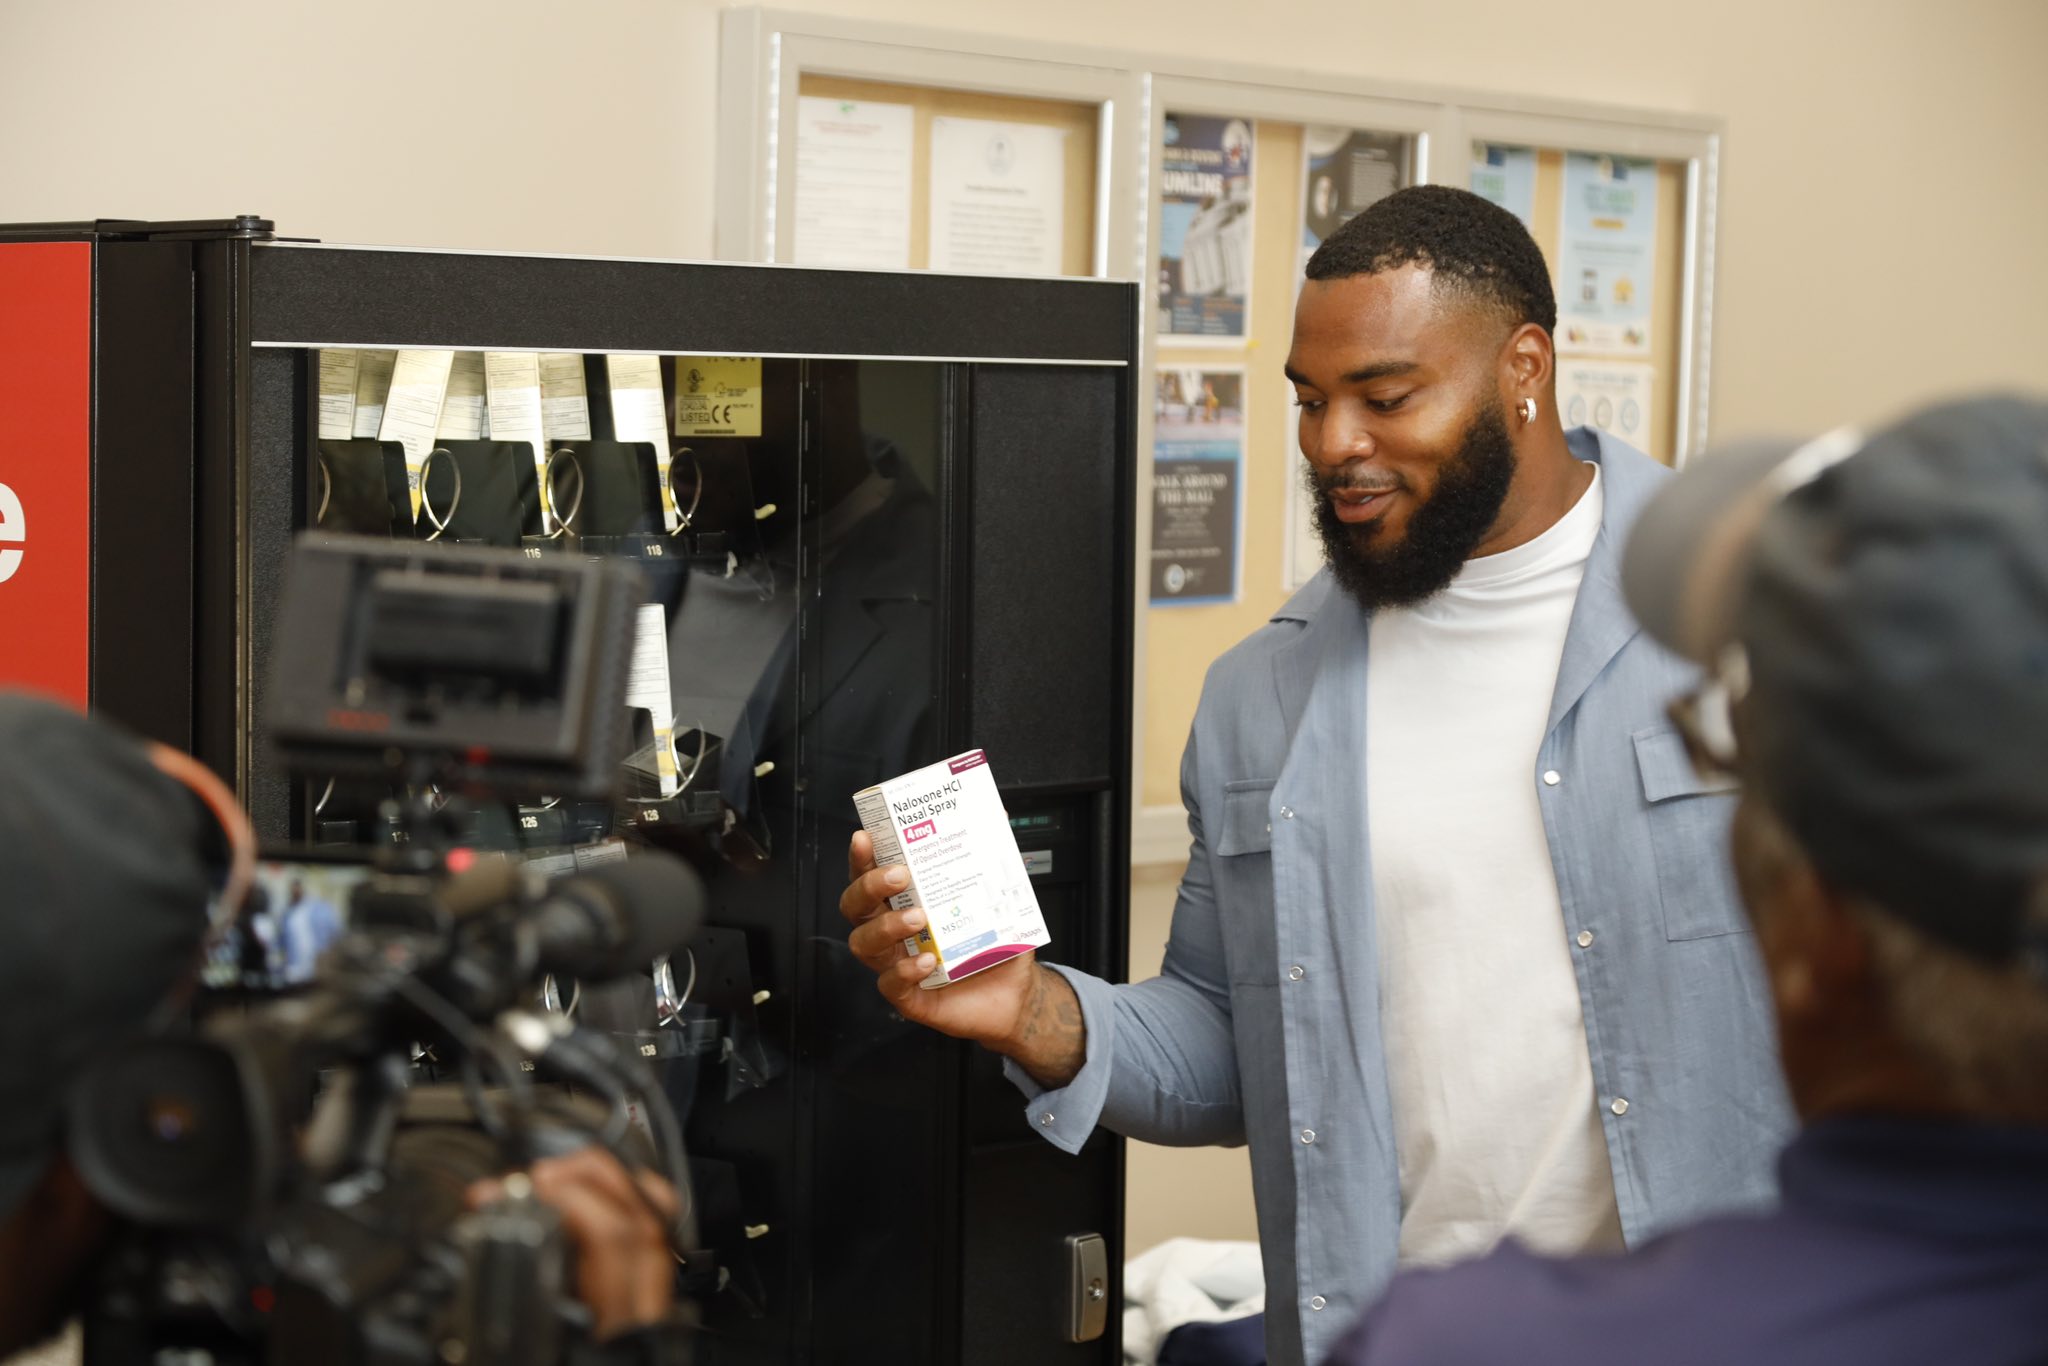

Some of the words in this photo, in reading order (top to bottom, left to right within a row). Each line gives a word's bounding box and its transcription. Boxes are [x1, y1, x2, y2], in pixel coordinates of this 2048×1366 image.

[524, 548, 542, 559] 116
[646, 544, 663, 556] 118
[892, 789, 943, 814] Naloxone
[897, 806, 928, 827] Nasal
[927, 798, 957, 816] Spray
[908, 840, 940, 856] Emergency
[939, 828, 968, 844] Treatment
[919, 851, 938, 864] Opioid
[937, 842, 962, 857] Overdose
